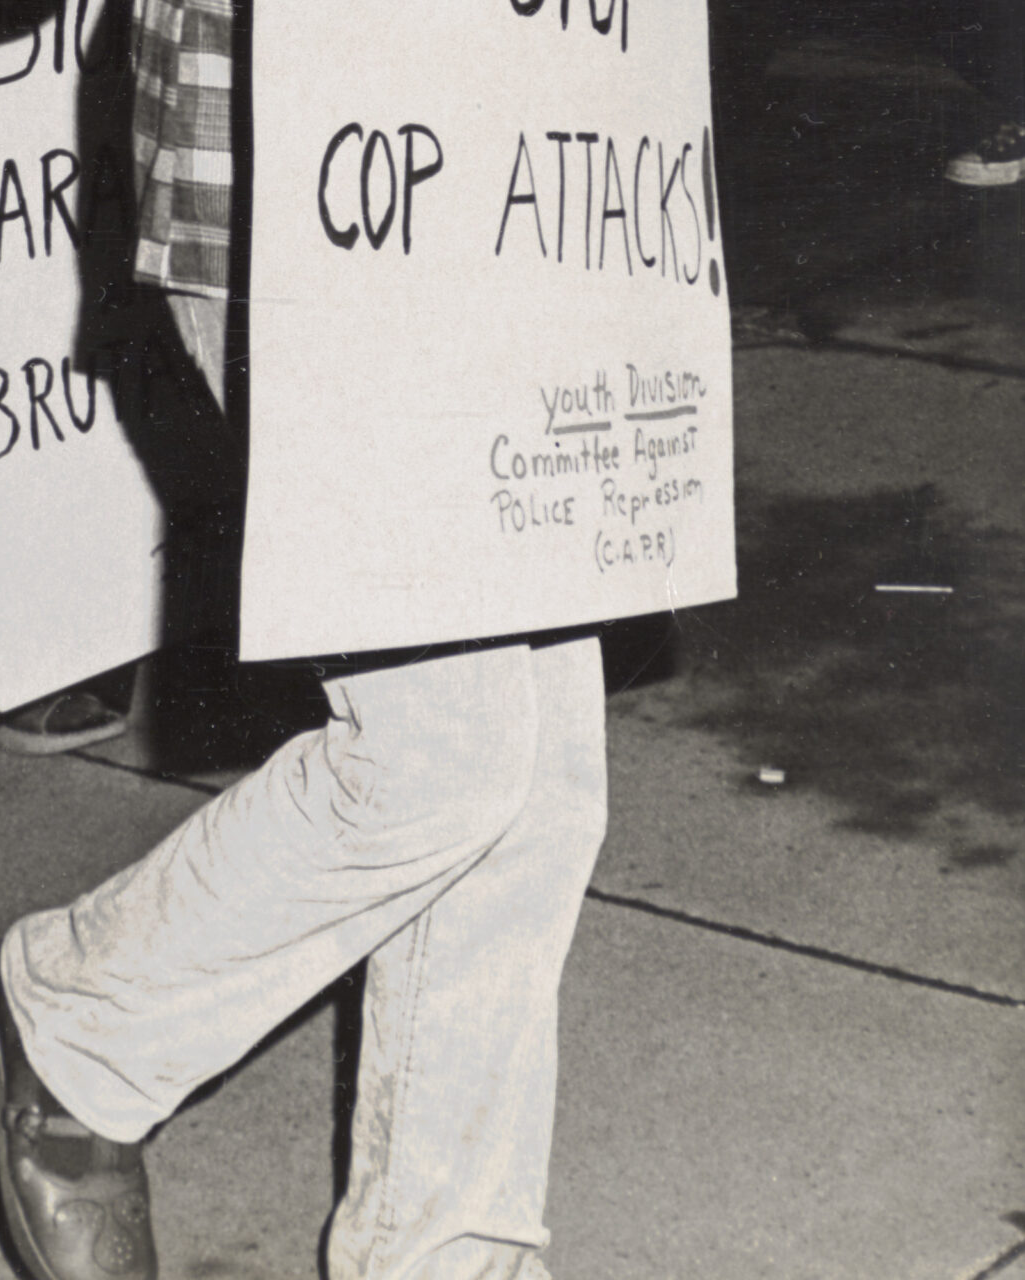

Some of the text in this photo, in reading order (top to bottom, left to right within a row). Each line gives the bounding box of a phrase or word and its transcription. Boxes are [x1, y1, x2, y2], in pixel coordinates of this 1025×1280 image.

[318, 123, 721, 297] COP ATTACKS!
[490, 434, 620, 480] Committee
[601, 478, 702, 525] Repression
